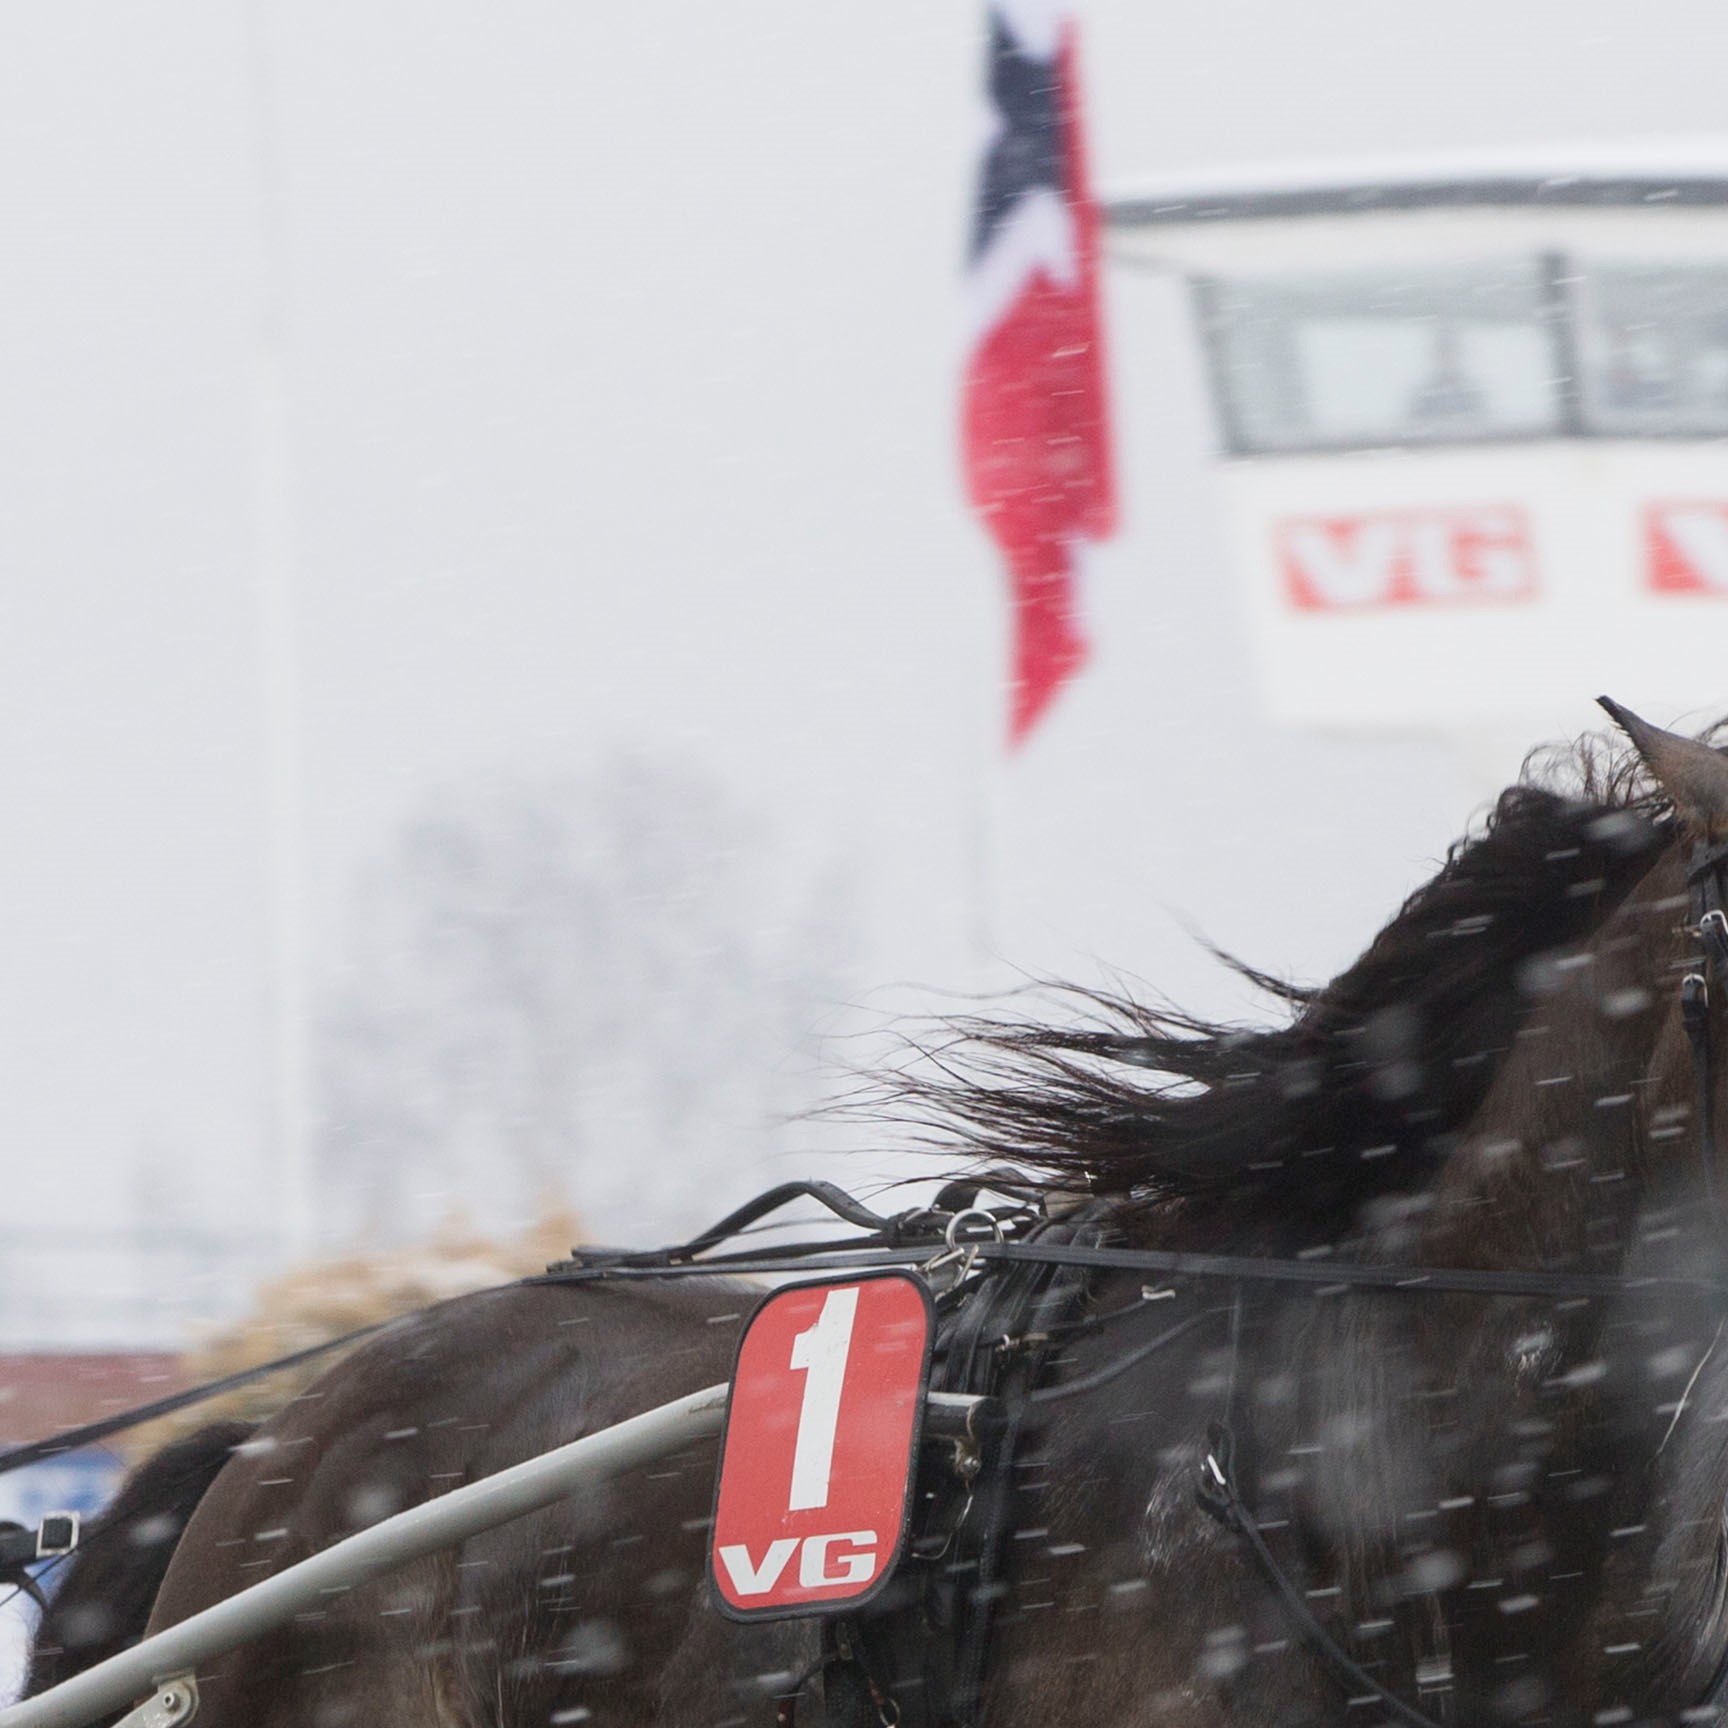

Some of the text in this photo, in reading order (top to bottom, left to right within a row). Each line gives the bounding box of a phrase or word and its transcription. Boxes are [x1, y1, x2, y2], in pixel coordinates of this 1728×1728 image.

[1282, 514, 1526, 602] VG
[789, 1286, 860, 1511] 1
[718, 1530, 878, 1596] VG
